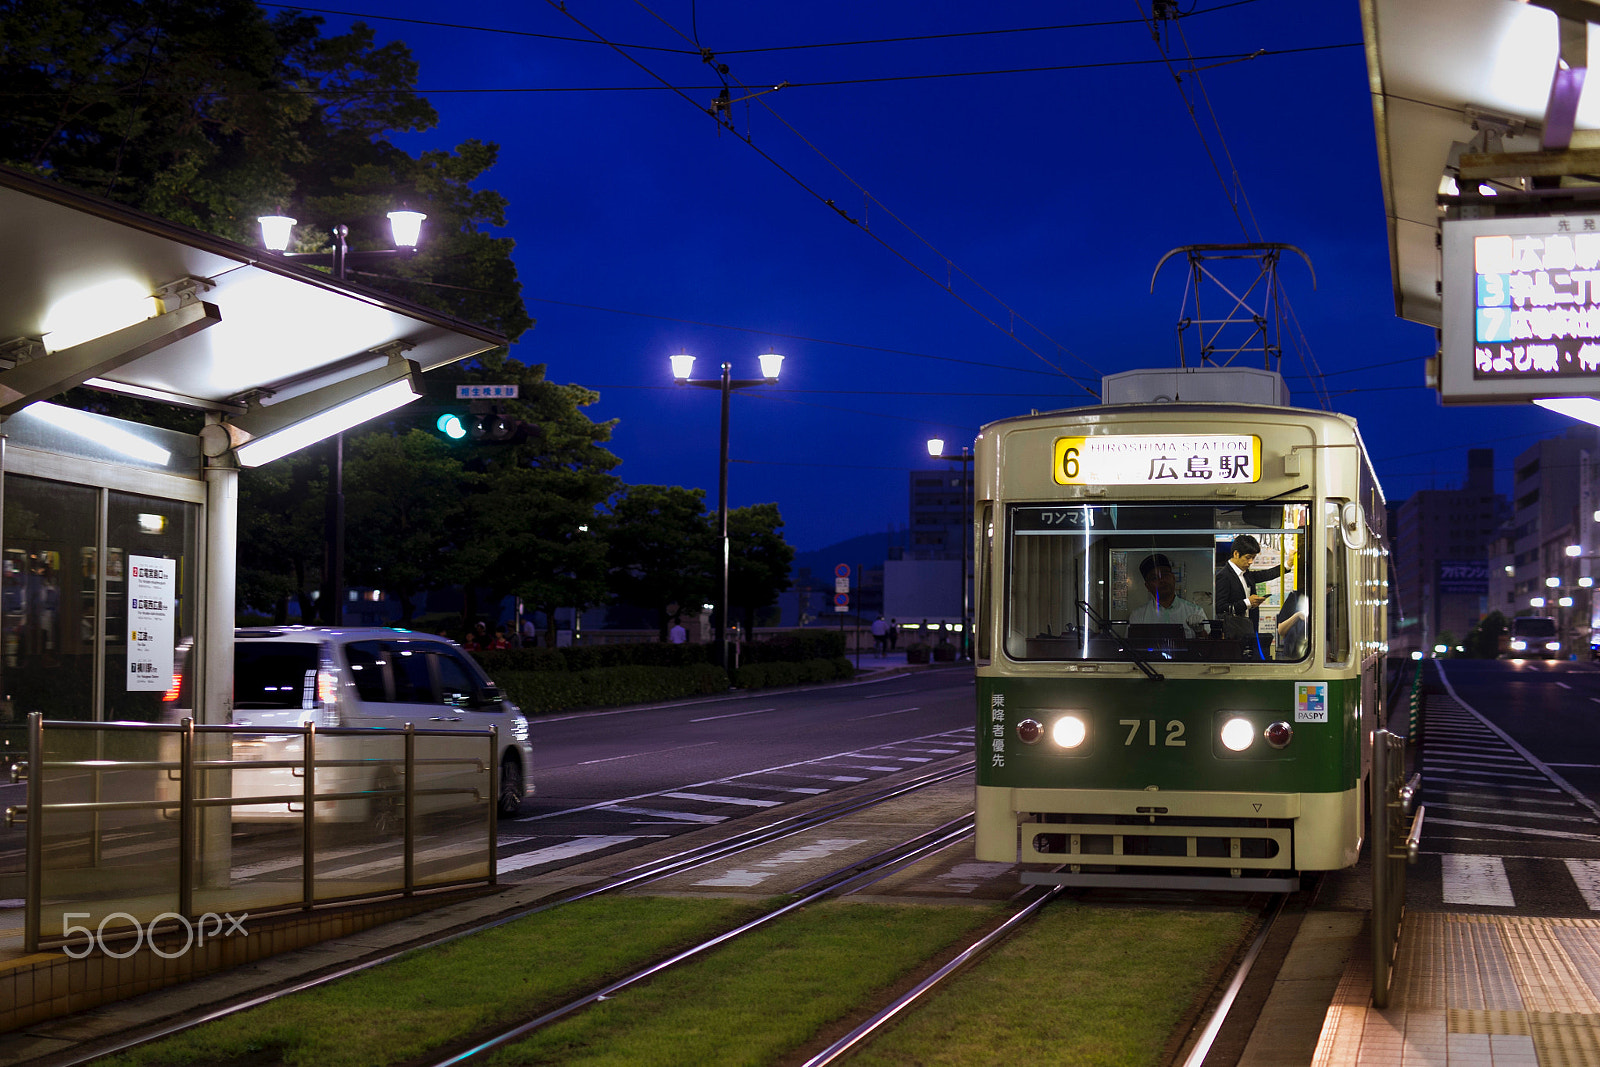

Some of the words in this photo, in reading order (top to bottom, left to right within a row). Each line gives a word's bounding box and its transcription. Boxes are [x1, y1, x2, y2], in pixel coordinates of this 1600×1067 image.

[1482, 307, 1505, 341] 7
[1091, 441, 1177, 452] HIROSHIMA
[1182, 441, 1248, 451] STATION
[1062, 447, 1080, 479] 6
[1147, 454, 1250, 480] 広島駅
[1298, 712, 1325, 720] PASPY
[992, 694, 1005, 767] 乗降者優先
[1119, 719, 1186, 747] 712
